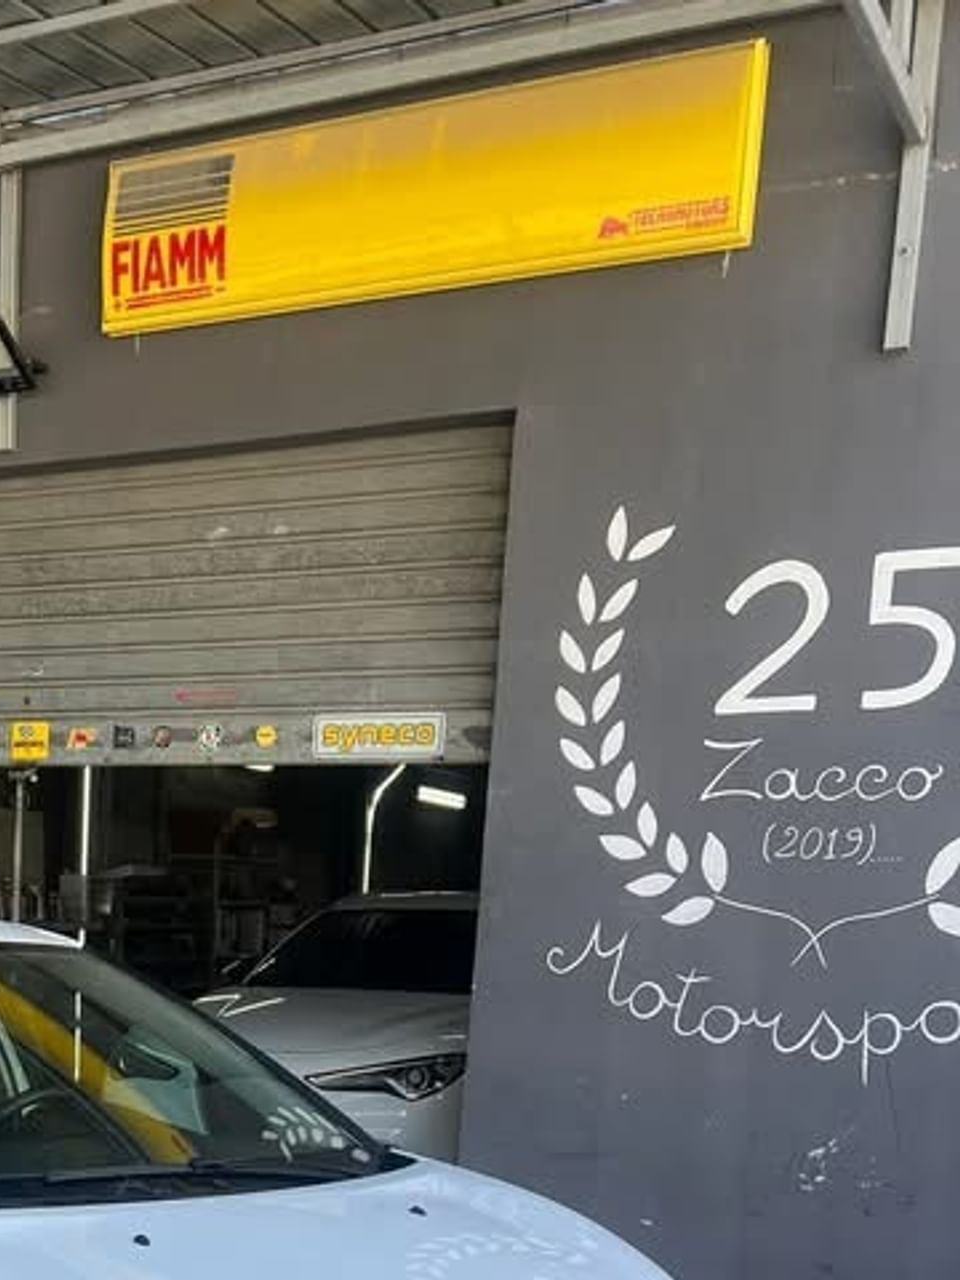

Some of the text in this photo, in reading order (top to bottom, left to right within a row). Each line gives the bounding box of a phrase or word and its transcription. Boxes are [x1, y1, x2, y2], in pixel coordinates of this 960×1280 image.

[112, 225, 225, 298] FIAMM
[714, 547, 960, 715] 25
[322, 722, 437, 753] syneco
[700, 737, 943, 802] Zacco
